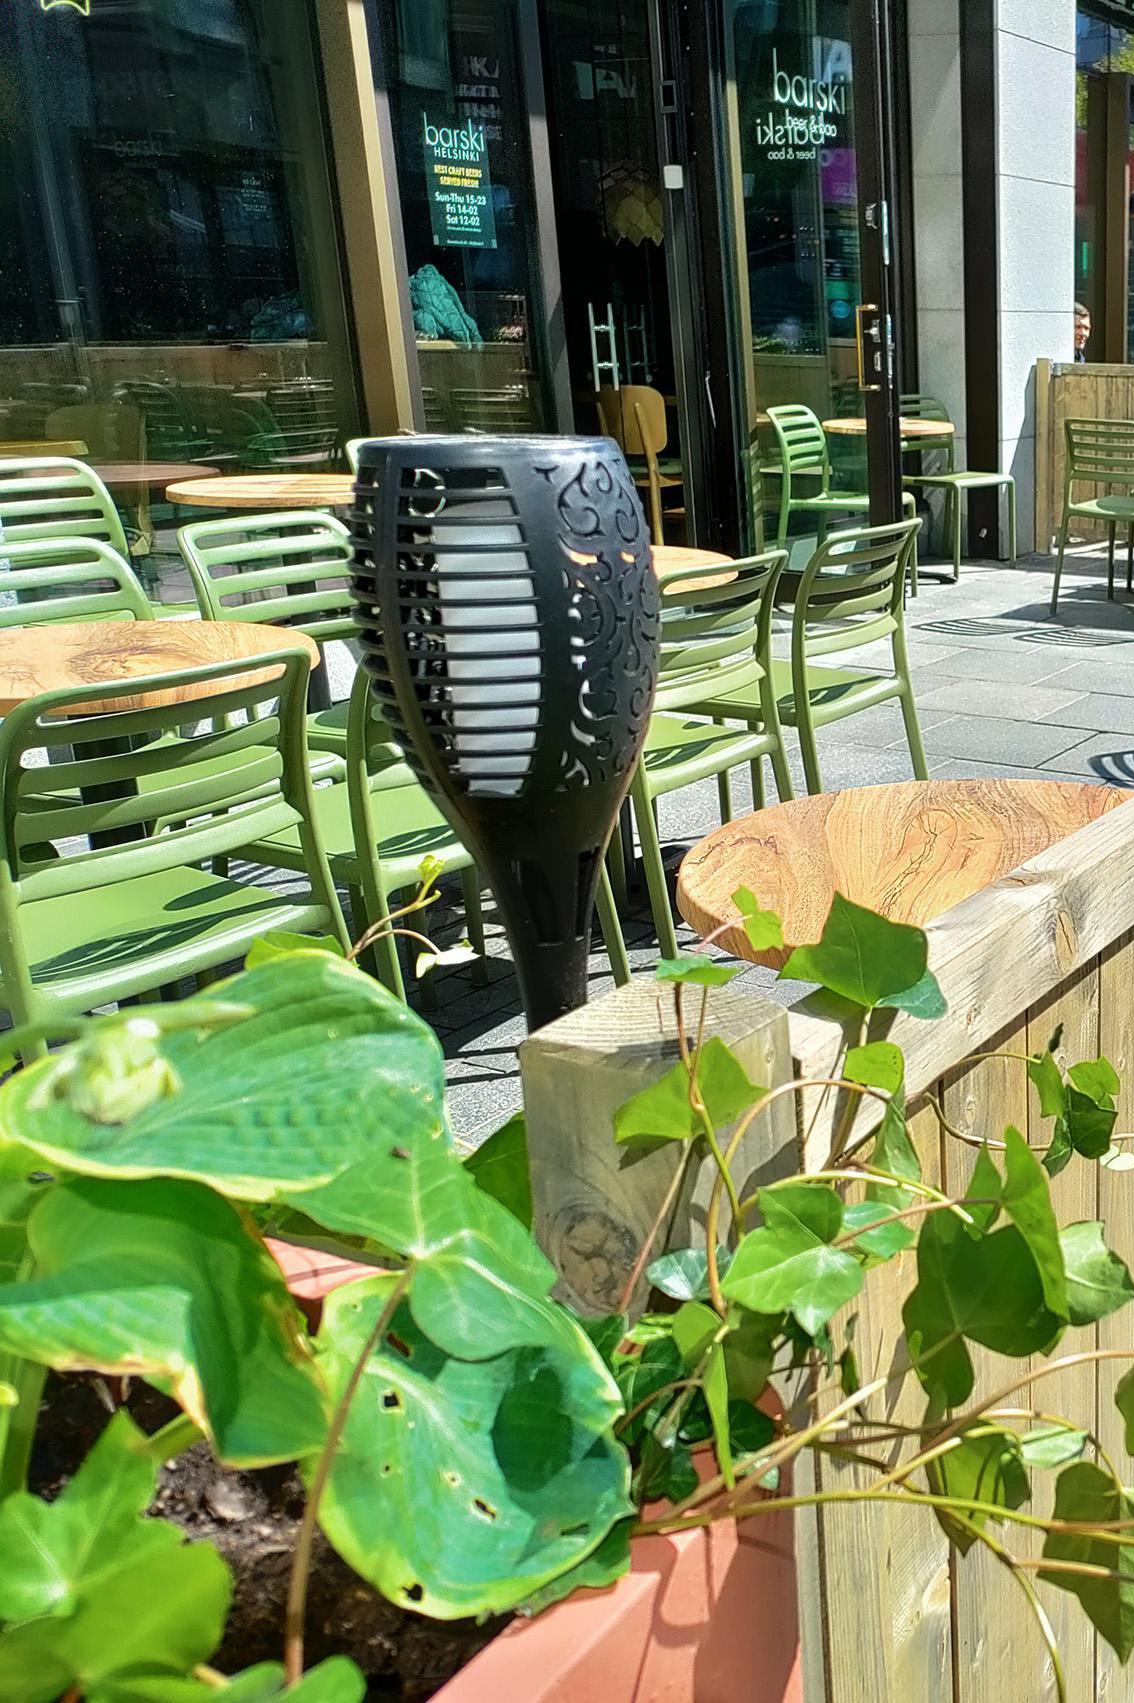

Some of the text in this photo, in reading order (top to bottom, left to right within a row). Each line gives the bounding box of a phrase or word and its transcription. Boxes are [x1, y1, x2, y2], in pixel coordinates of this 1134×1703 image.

[773, 47, 845, 115] barski
[423, 111, 485, 152] barski
[433, 146, 480, 162] HELSINKI
[435, 191, 487, 206] Sun-Thu 15-23
[446, 203, 478, 215] Fri 14-02
[446, 214, 480, 226] Sat 12-02
